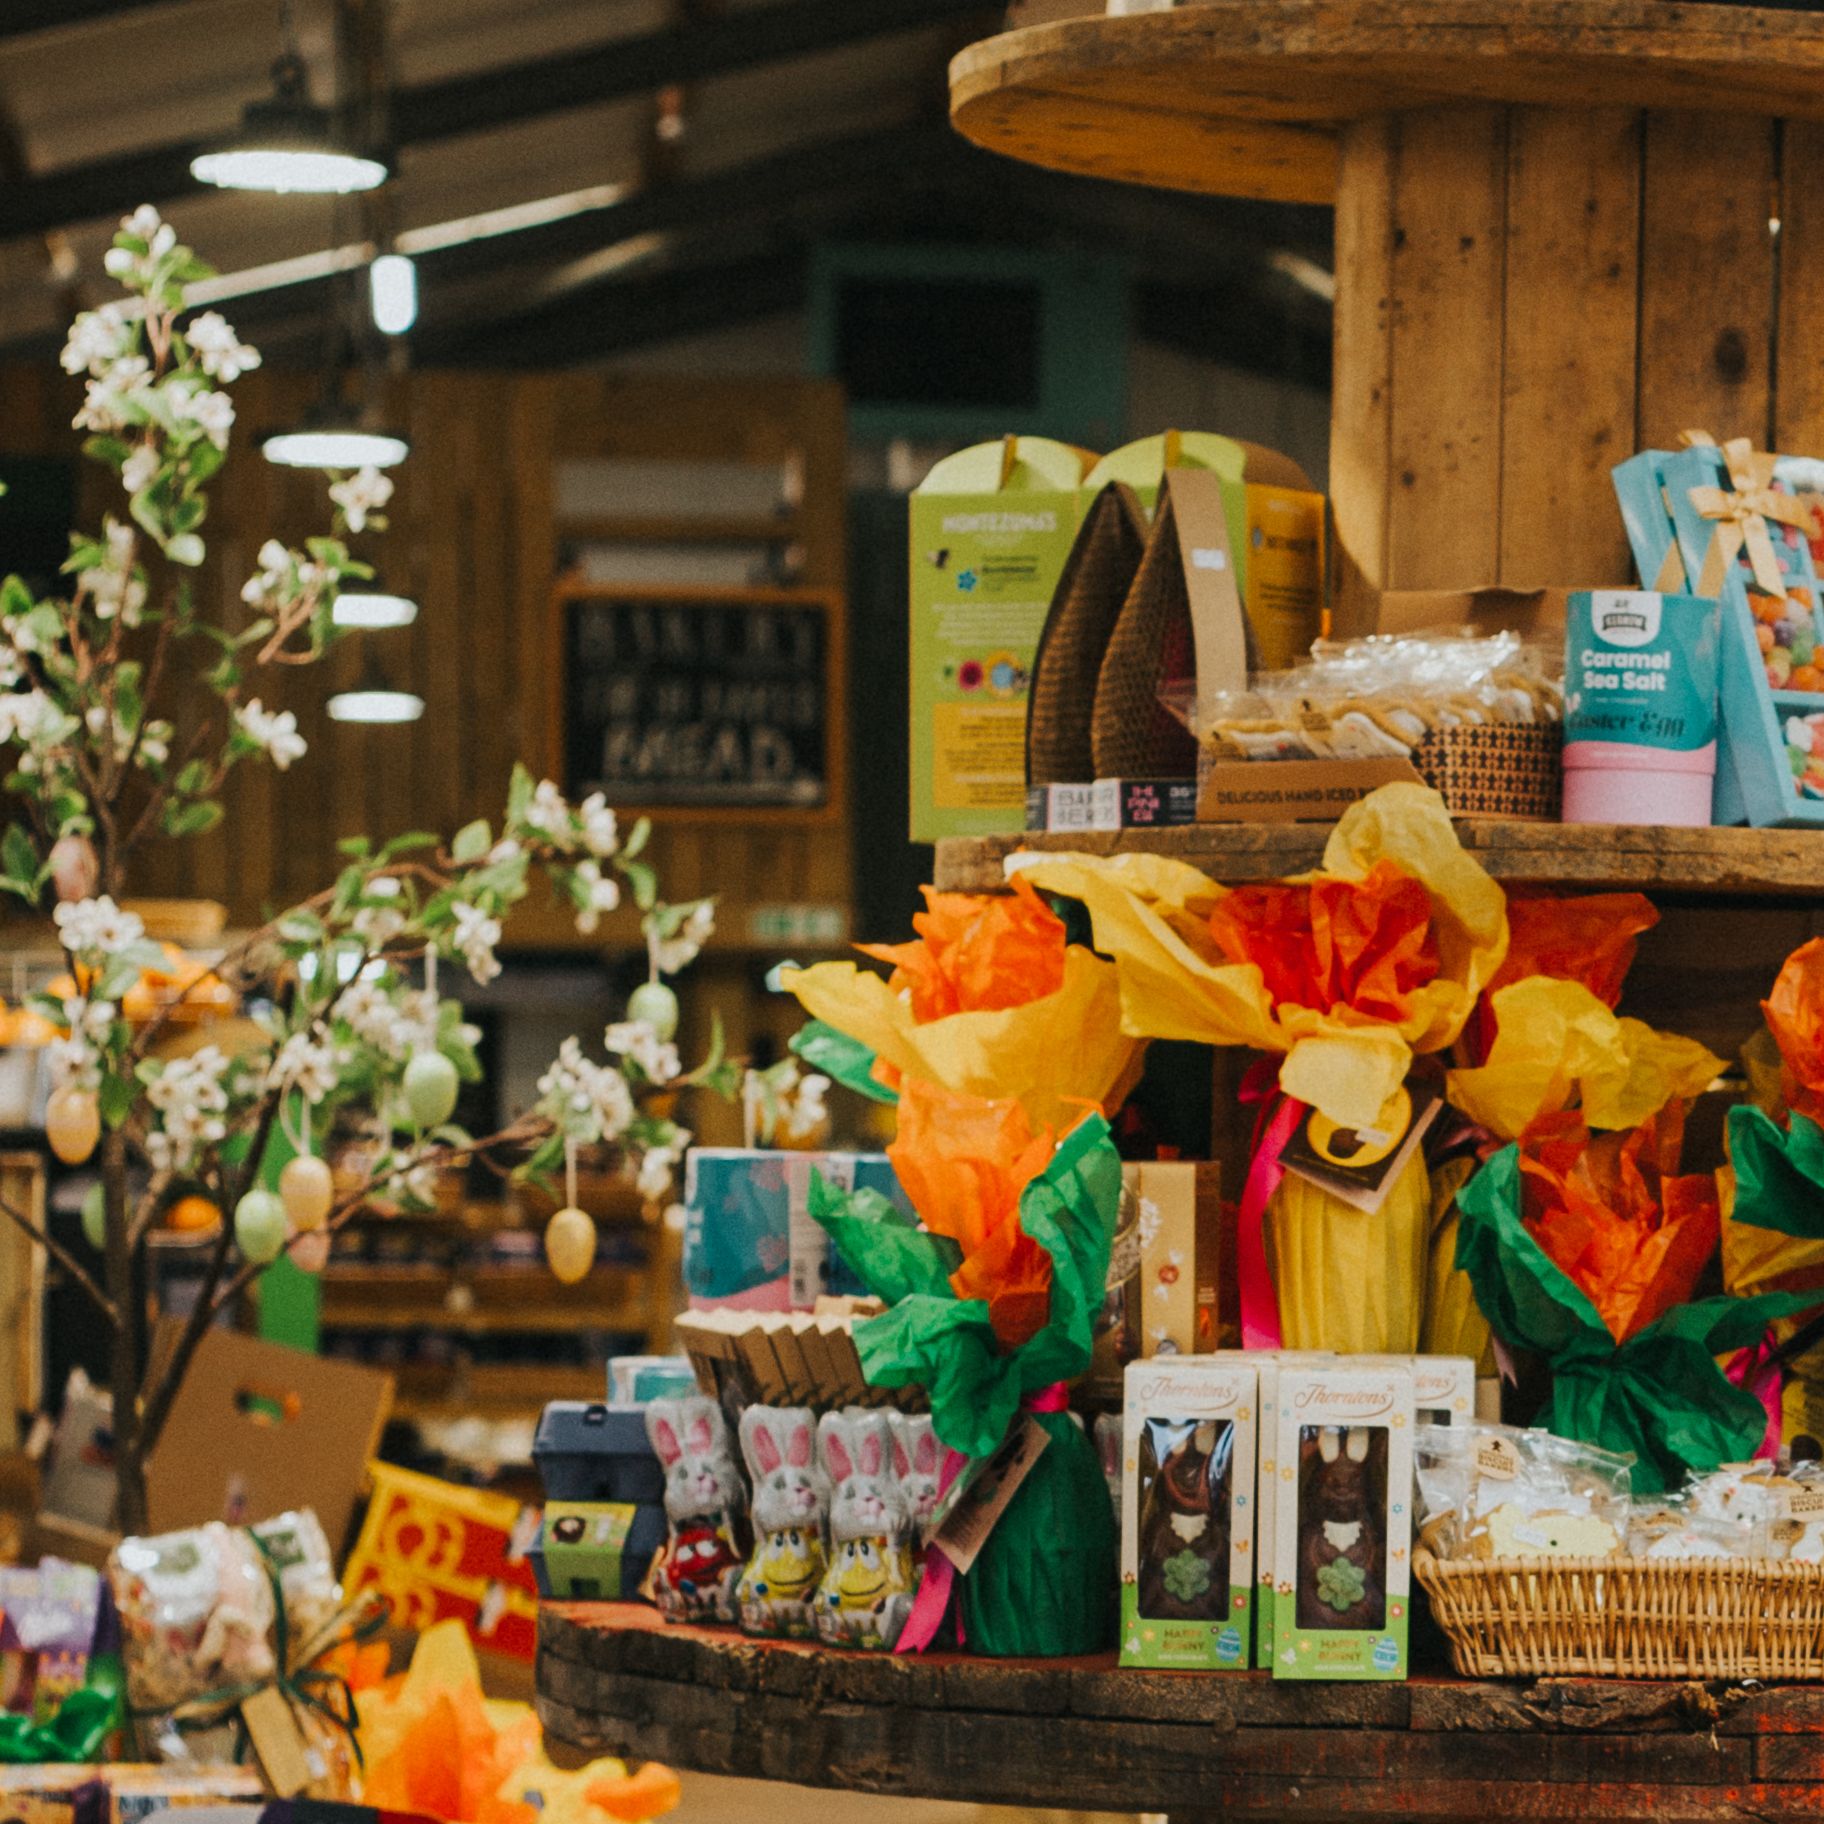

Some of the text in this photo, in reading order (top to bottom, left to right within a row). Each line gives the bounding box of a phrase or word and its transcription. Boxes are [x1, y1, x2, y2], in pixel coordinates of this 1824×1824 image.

[1581, 650, 1671, 670] Caramel
[1584, 671, 1666, 691] Sea Salt
[1295, 1383, 1395, 1418] Thorntons
